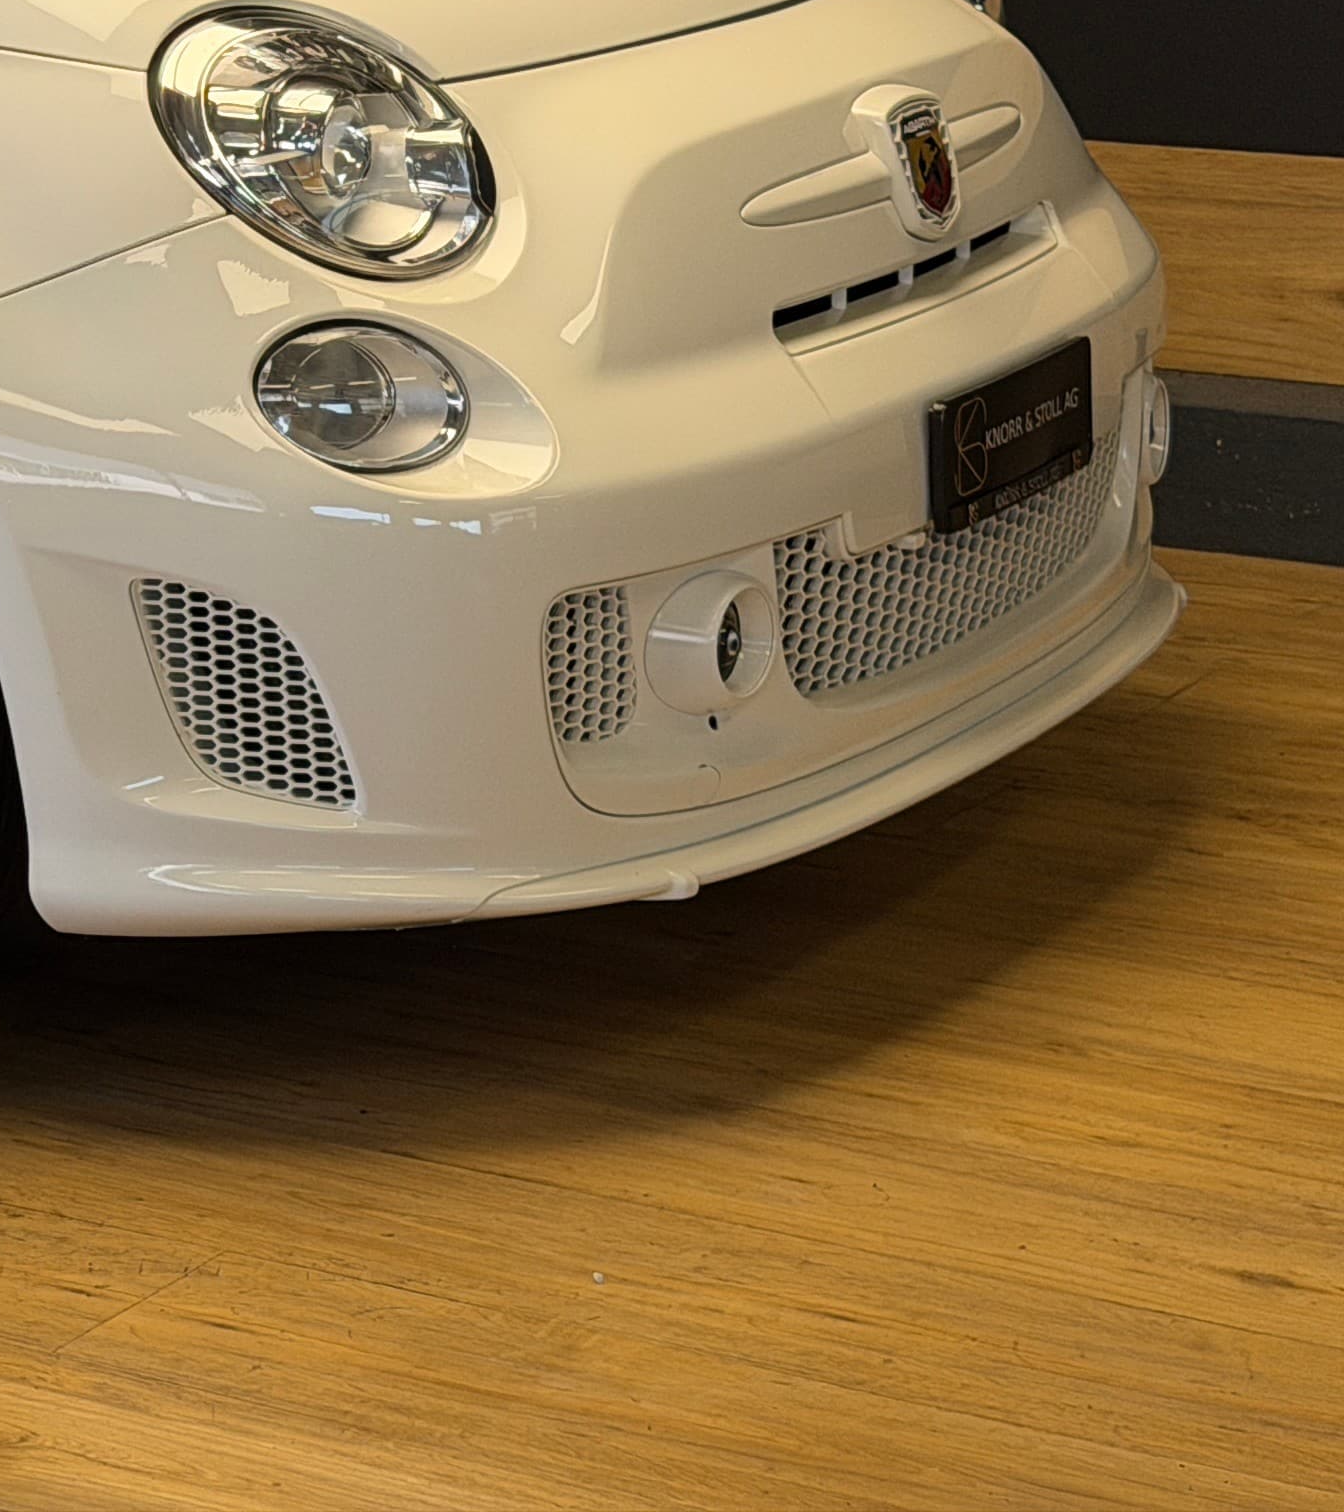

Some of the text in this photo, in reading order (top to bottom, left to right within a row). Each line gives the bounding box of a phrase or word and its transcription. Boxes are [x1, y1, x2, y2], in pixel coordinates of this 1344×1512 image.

[985, 387, 1079, 450] KNORR & STOLL AG
